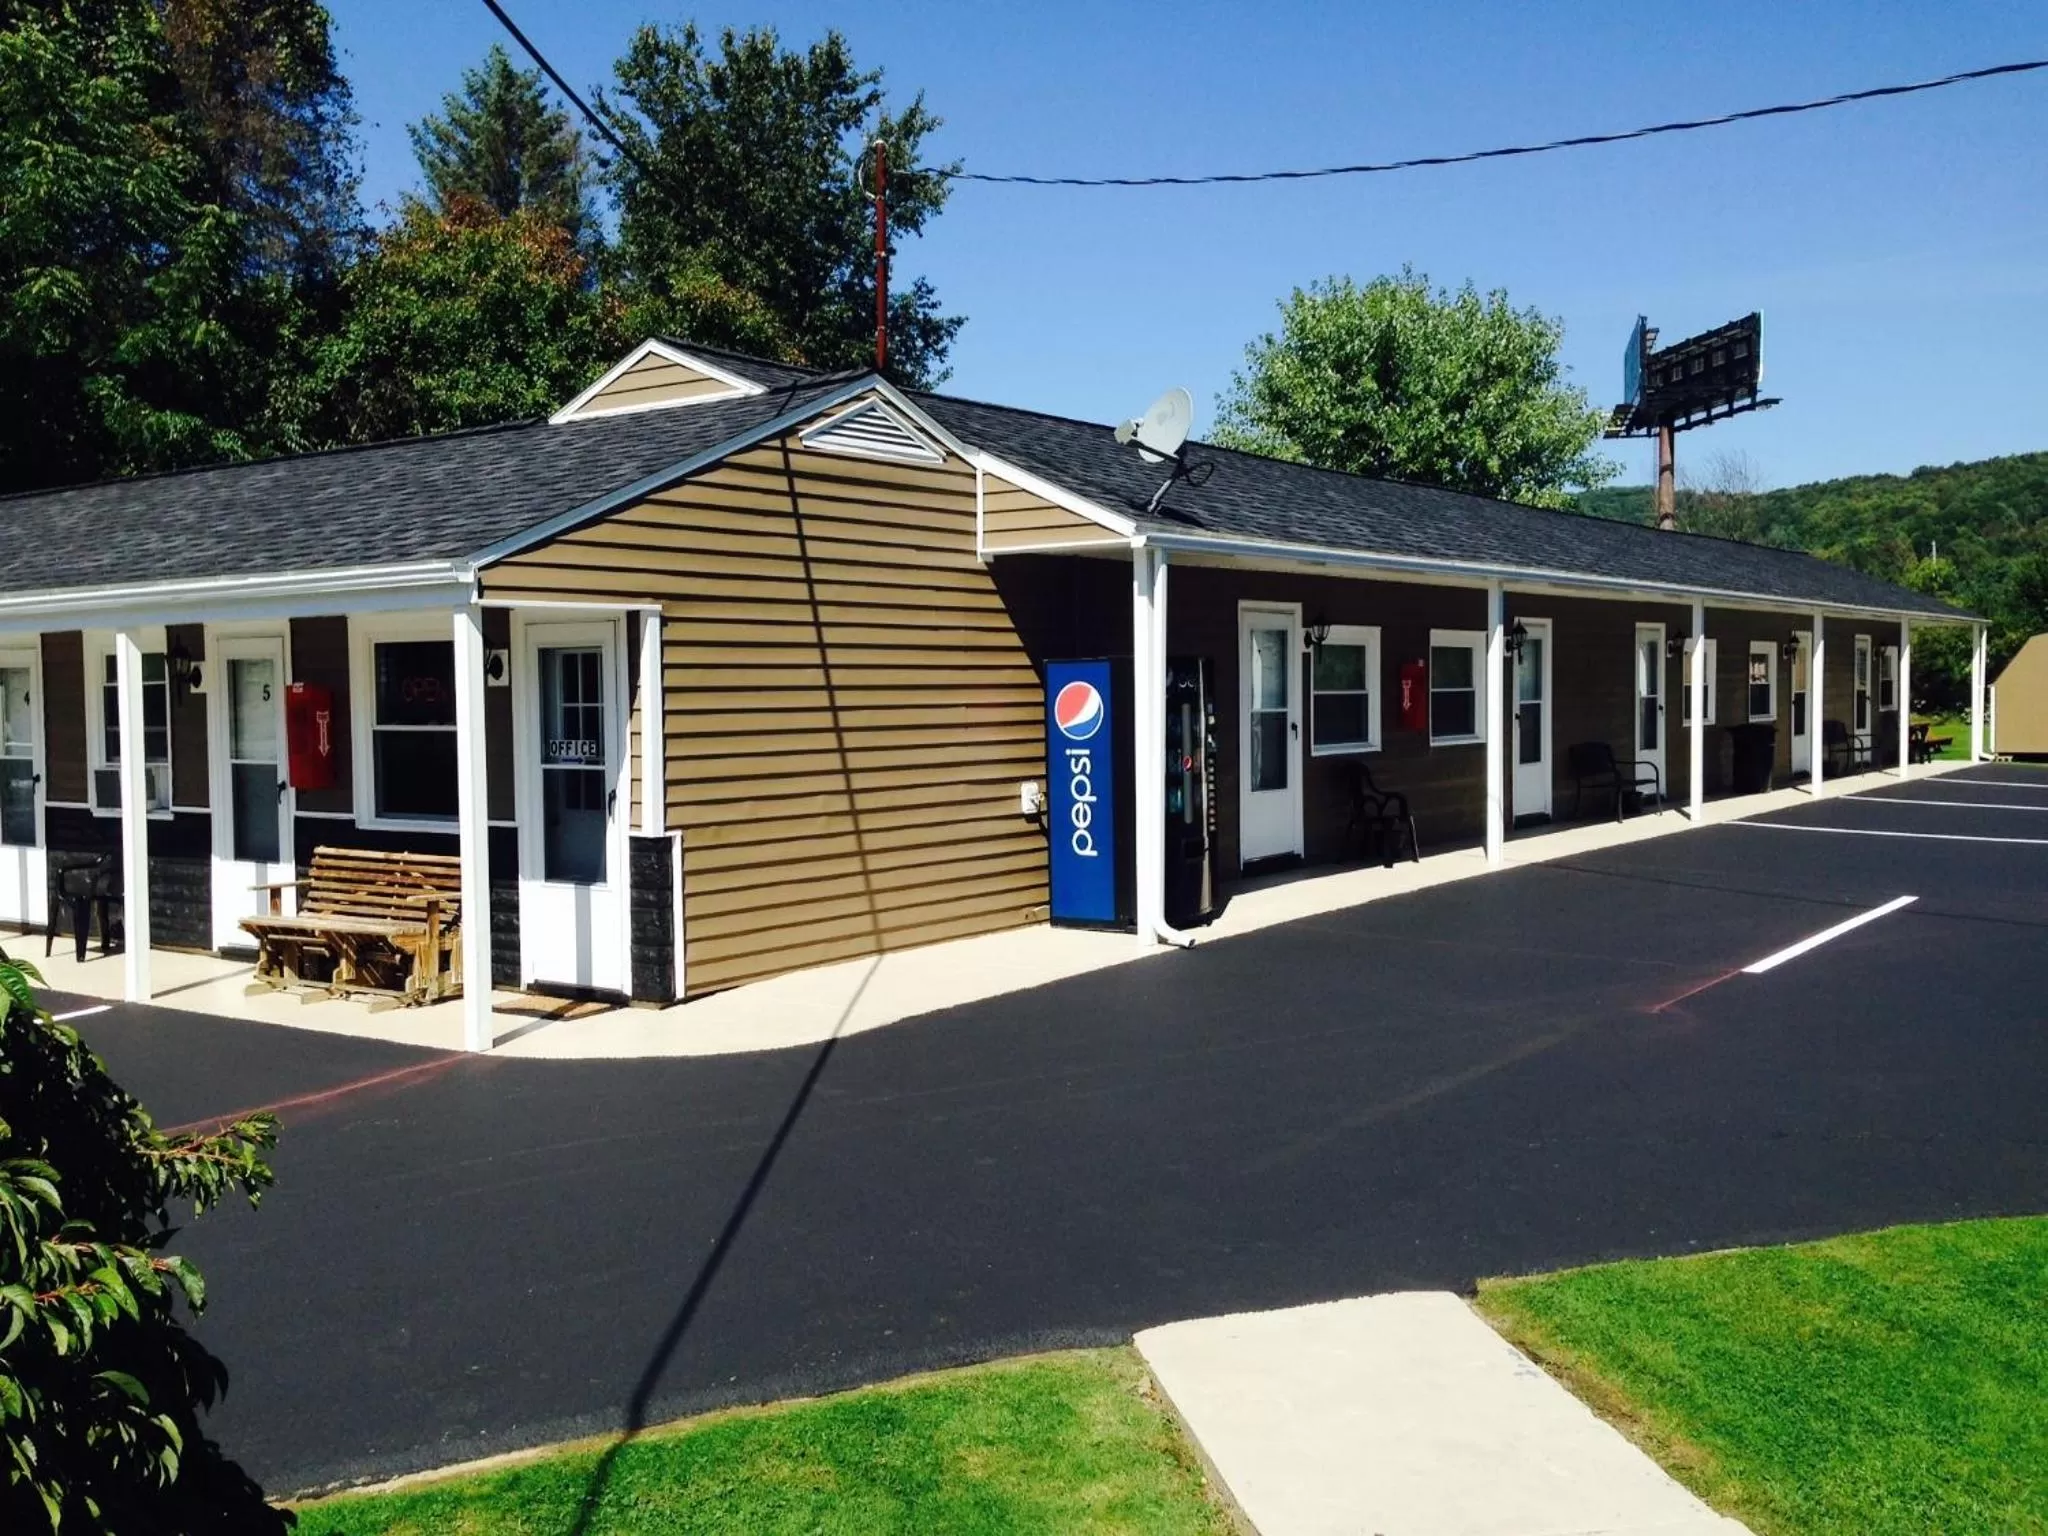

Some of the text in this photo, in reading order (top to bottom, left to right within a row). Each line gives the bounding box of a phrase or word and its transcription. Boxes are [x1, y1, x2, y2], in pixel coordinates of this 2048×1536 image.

[262, 684, 271, 702] 5
[550, 741, 596, 756] OFFICE
[1065, 749, 1098, 857] pepsi
